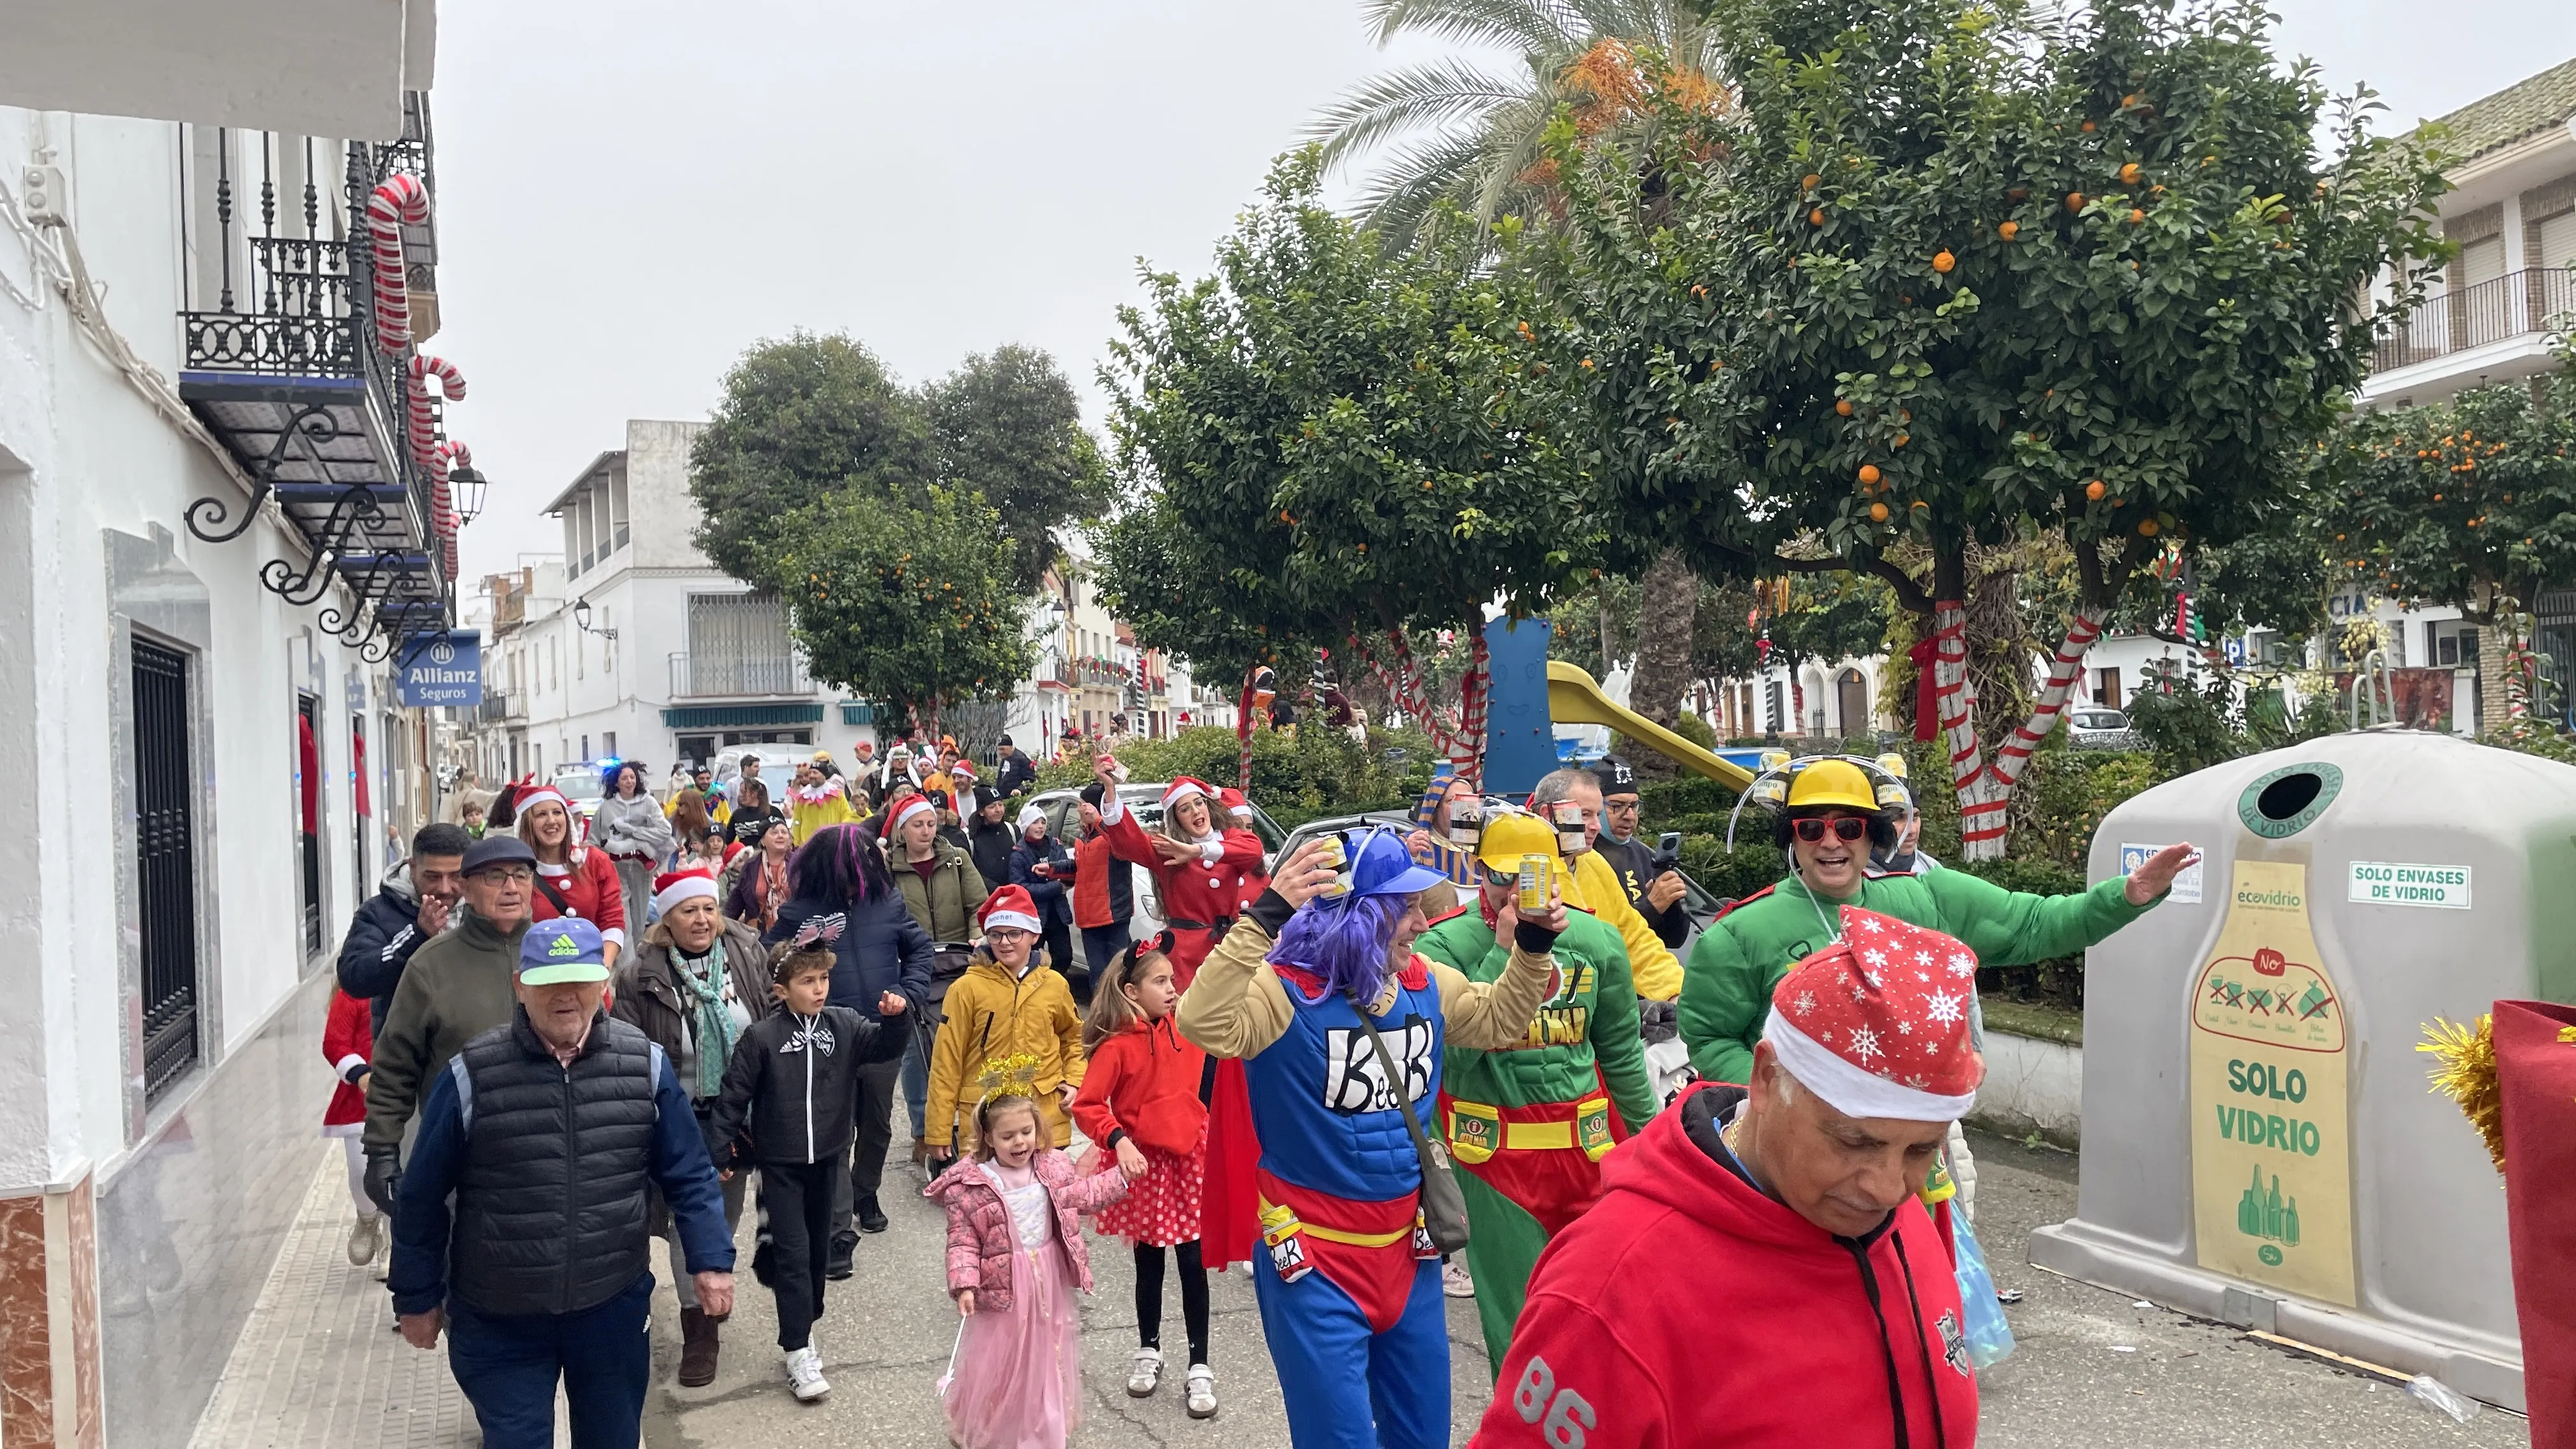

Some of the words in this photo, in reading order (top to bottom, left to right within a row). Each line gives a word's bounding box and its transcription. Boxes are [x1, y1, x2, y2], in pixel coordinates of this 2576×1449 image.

[410, 668, 477, 684] Allianz
[420, 687, 467, 702] Seguros
[2248, 766, 2294, 792] SOLO
[2301, 763, 2340, 797] ENVASES
[2242, 806, 2258, 825] DE
[2260, 809, 2316, 836] VIDRIO
[2356, 867, 2393, 882] SOLO
[2397, 869, 2464, 885] ENVASES
[1625, 870, 1643, 904] MA
[2372, 885, 2390, 898] DE
[2395, 885, 2445, 901] VIDRIO
[2238, 890, 2301, 907] ecovidrio
[549, 947, 579, 956] adidas
[2259, 954, 2281, 970] No
[2228, 1059, 2307, 1104] SOLO
[2216, 1103, 2320, 1157] VIDRIO
[1514, 1355, 1597, 1448] 86
